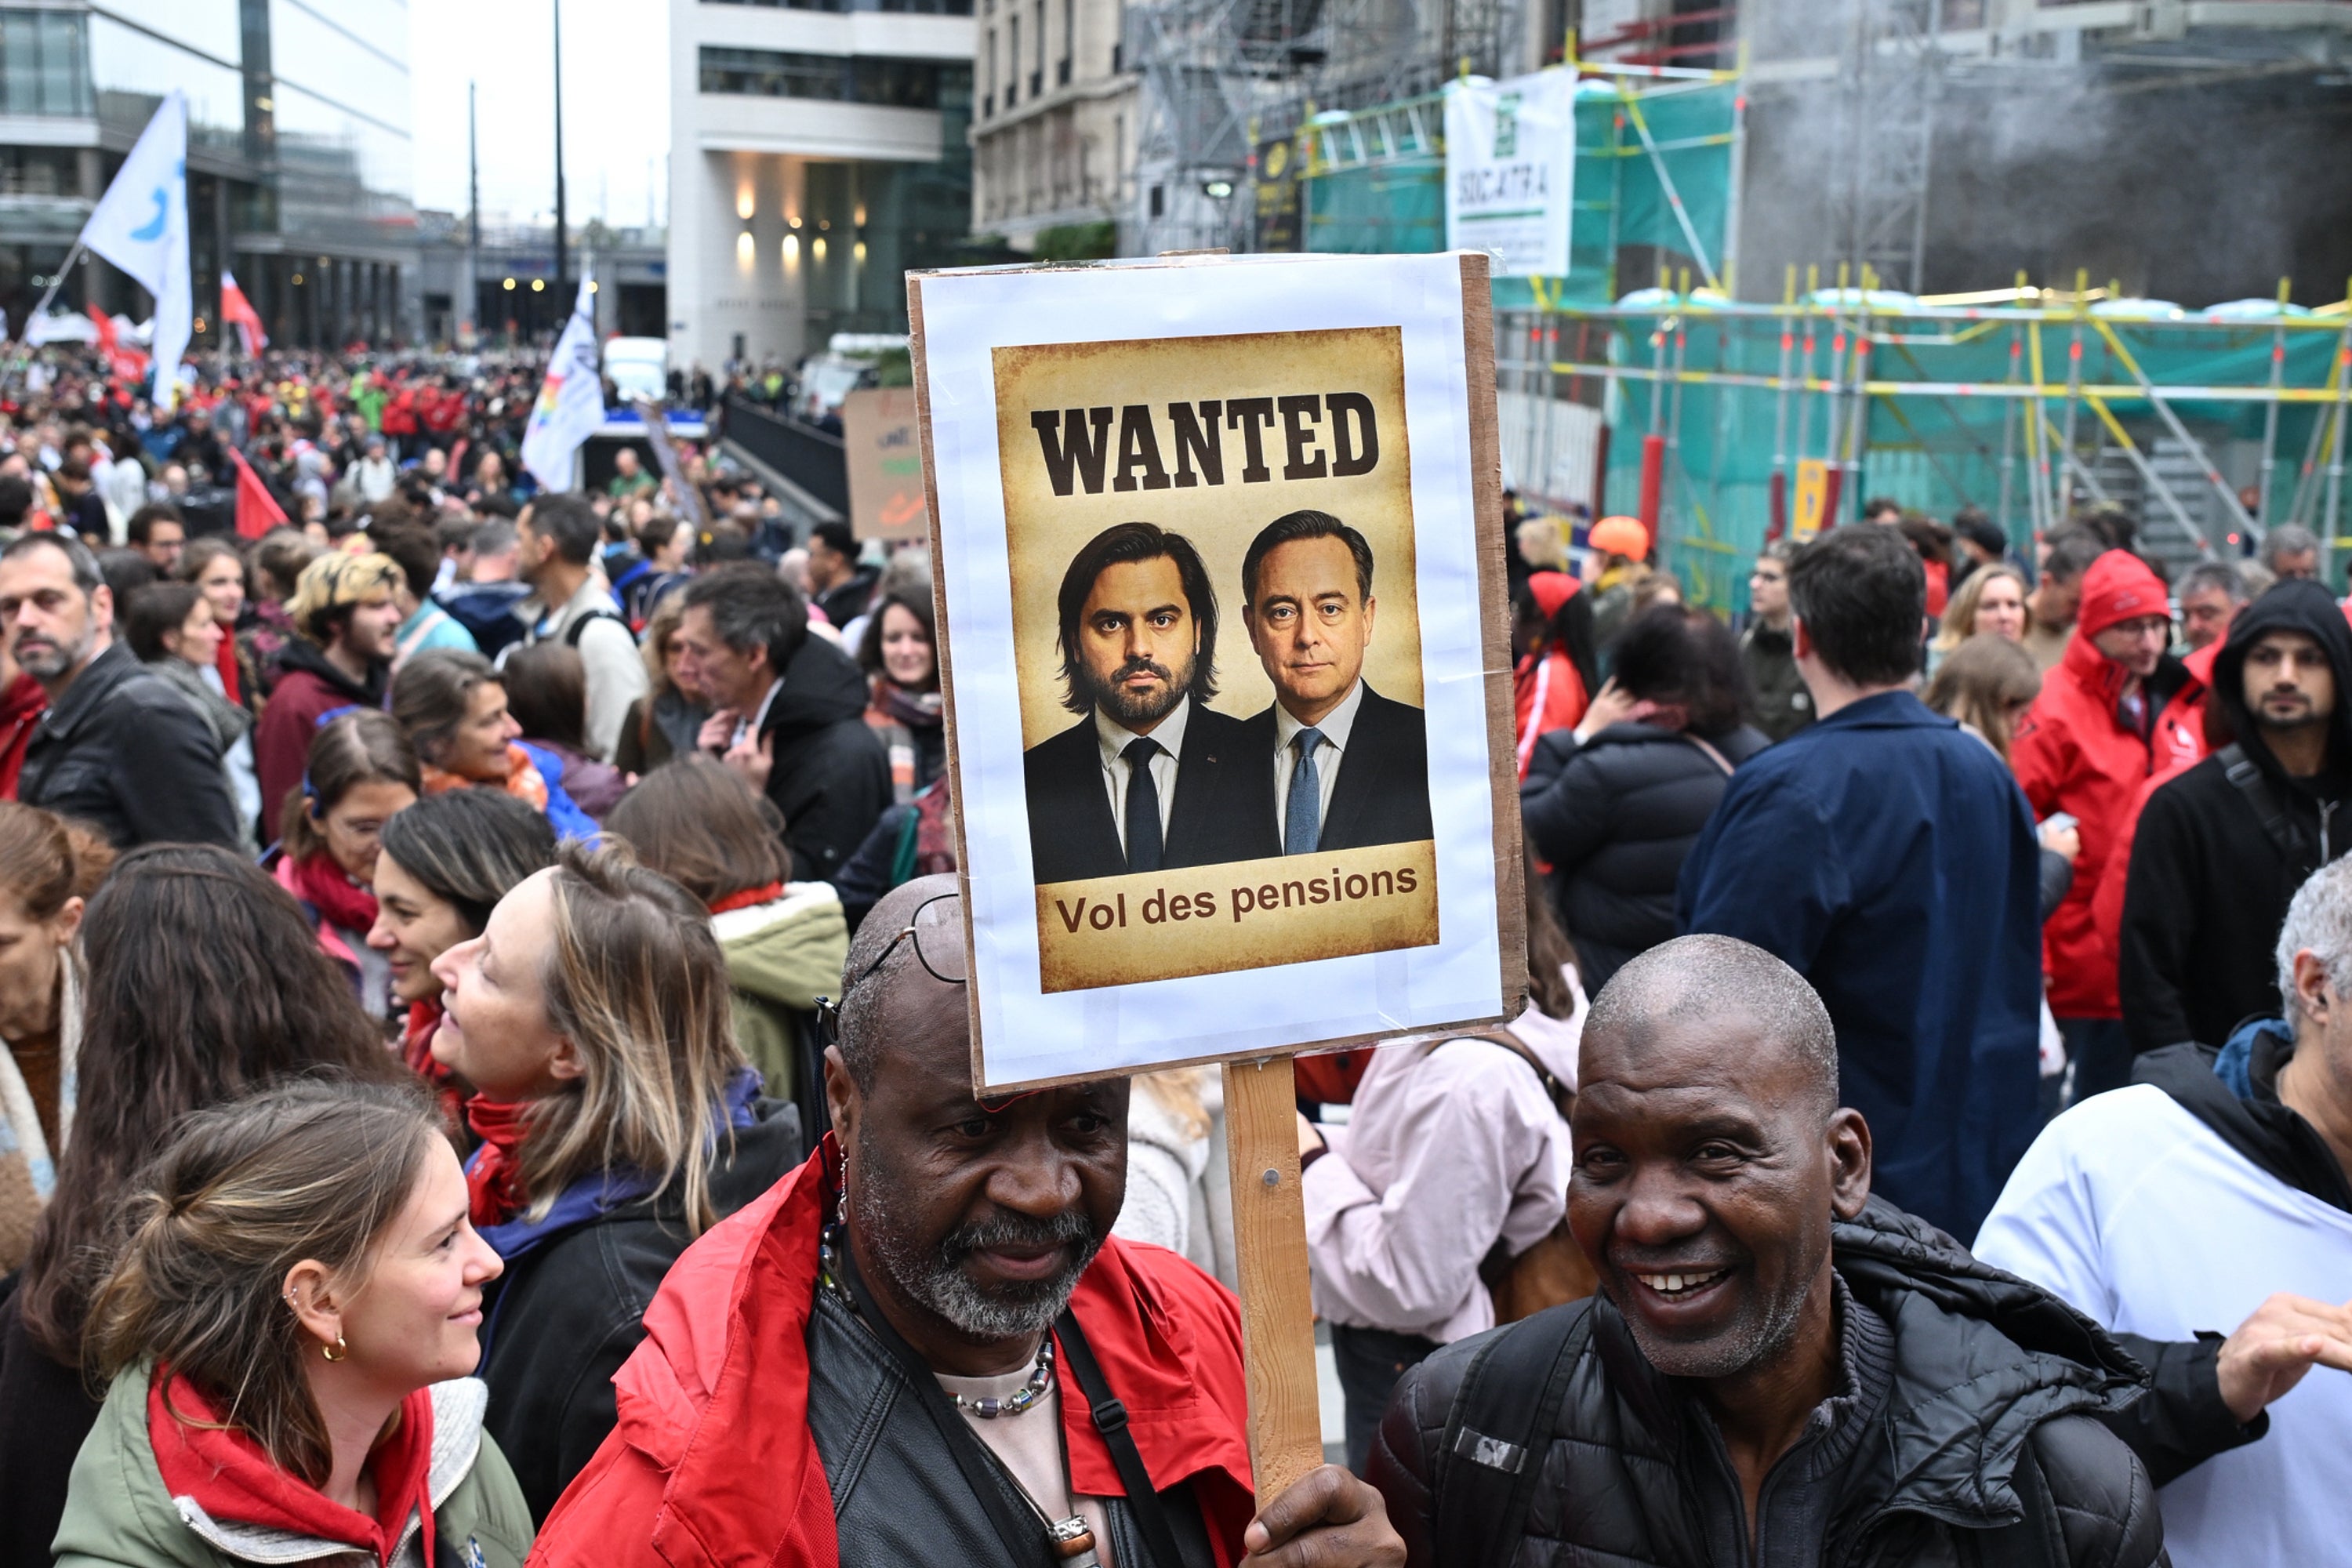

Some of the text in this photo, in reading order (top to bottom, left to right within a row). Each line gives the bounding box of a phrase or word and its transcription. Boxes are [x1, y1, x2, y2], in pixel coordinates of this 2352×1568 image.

[1031, 392, 1379, 496] WANTED
[1055, 867, 1417, 933] Vol des pensions
